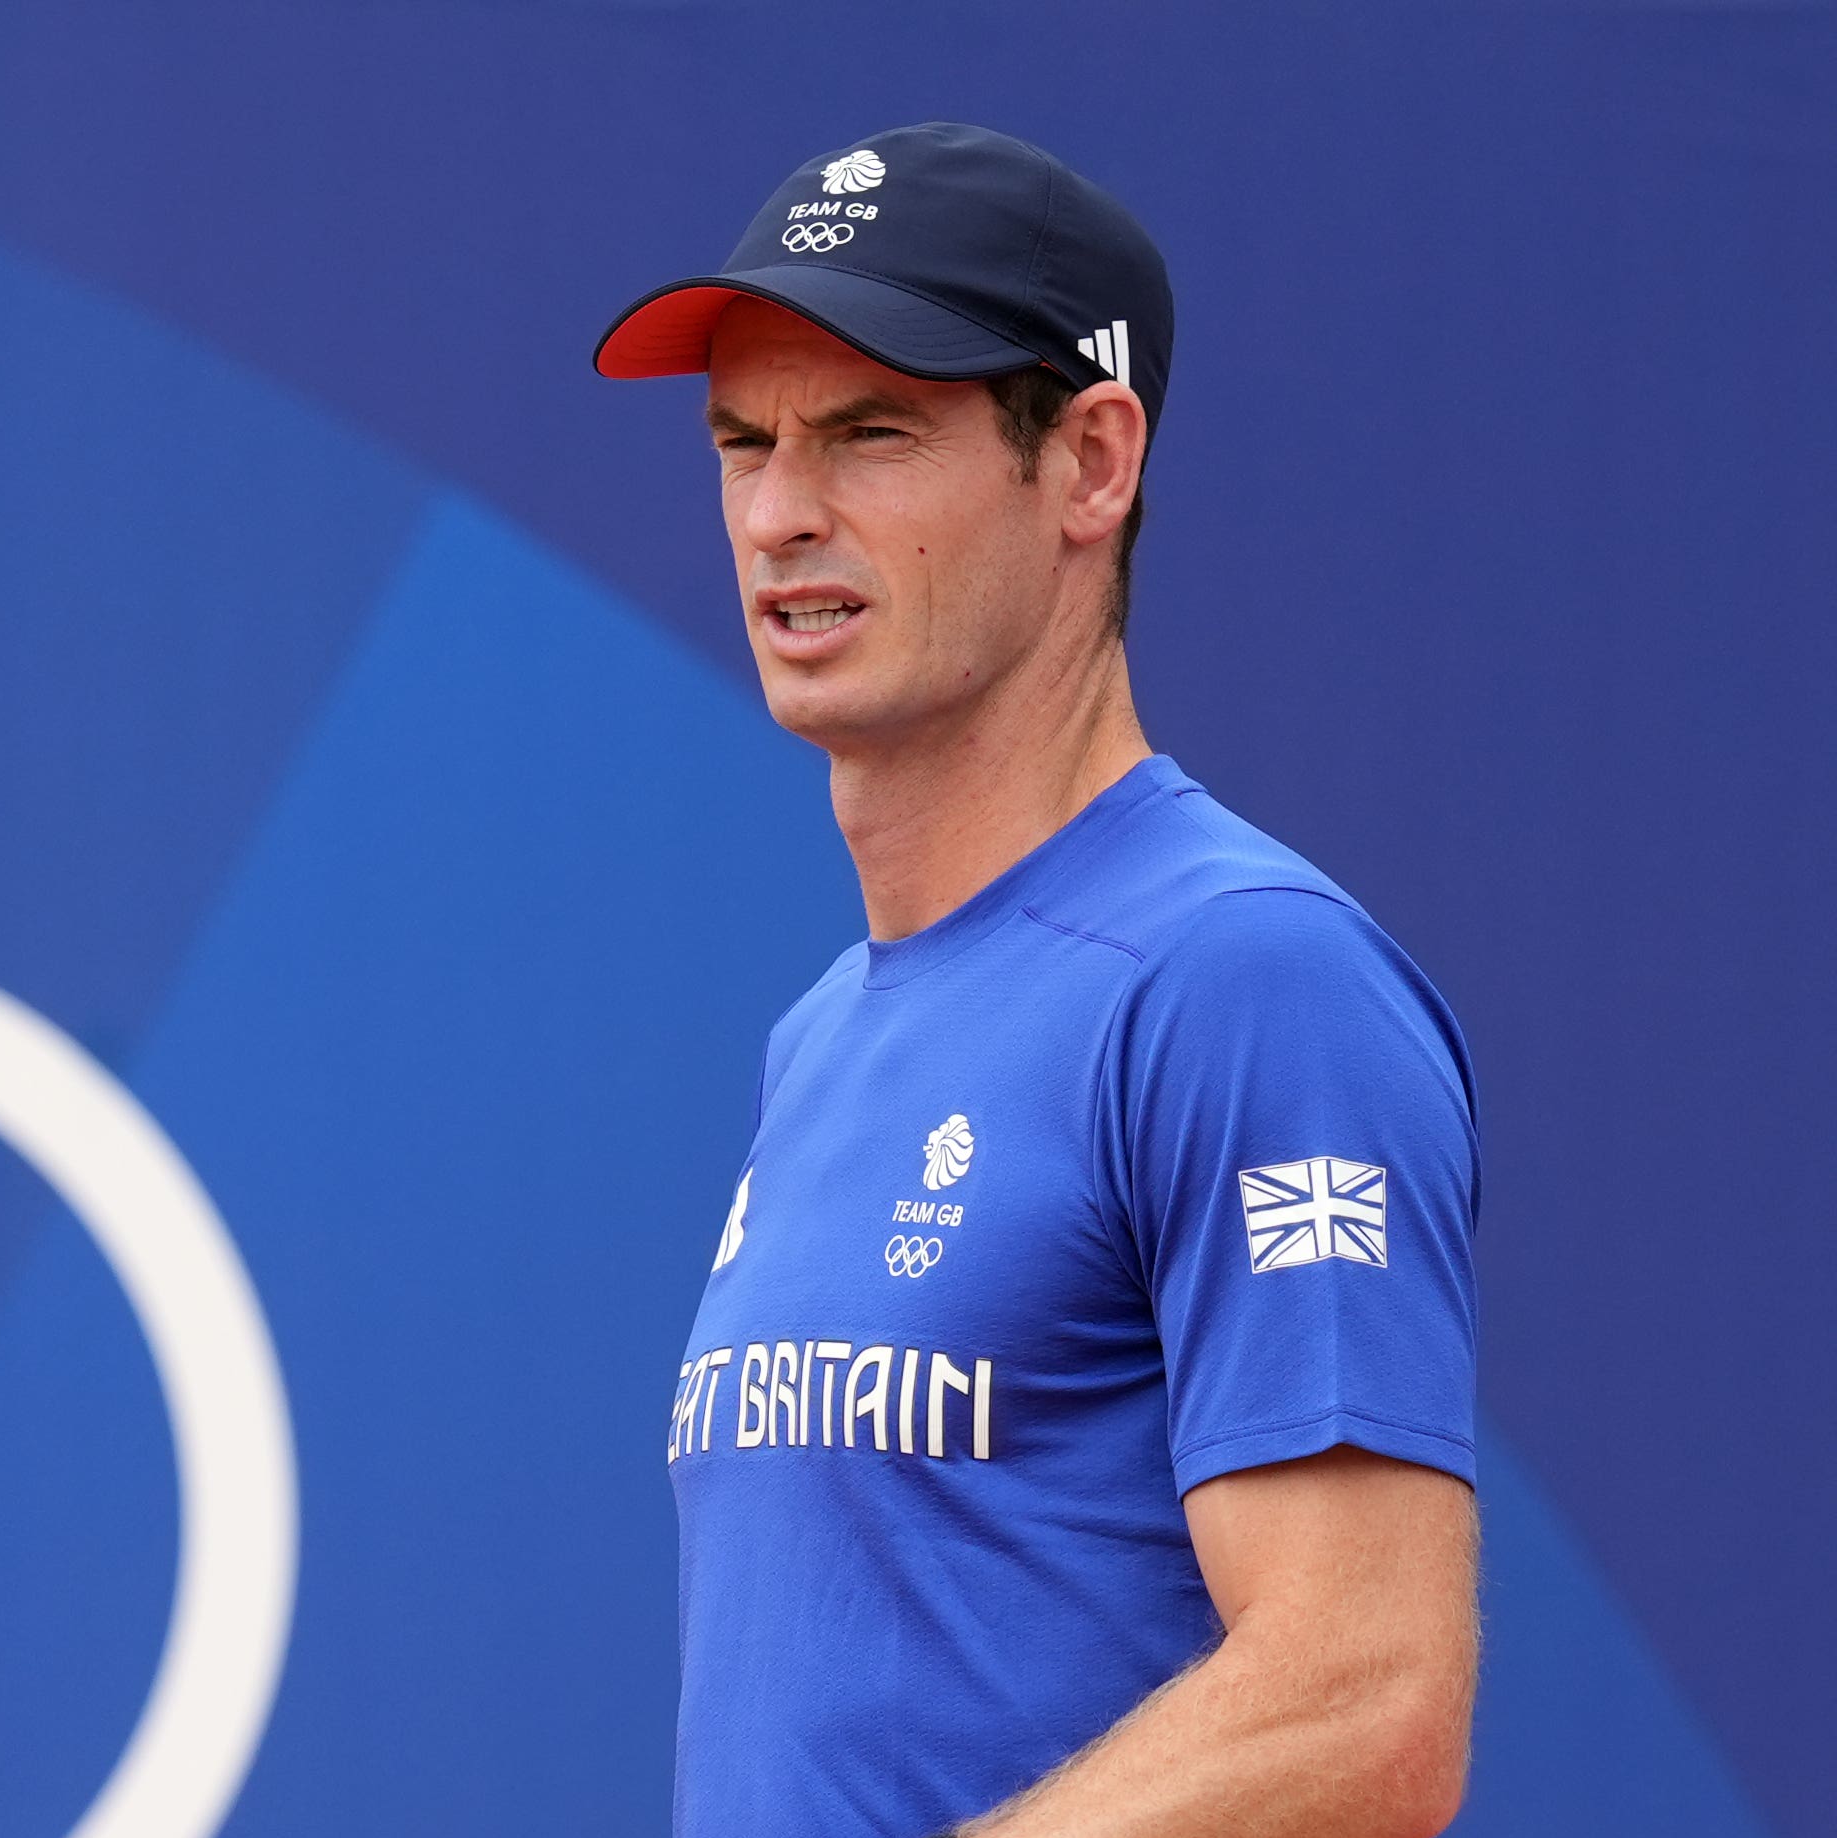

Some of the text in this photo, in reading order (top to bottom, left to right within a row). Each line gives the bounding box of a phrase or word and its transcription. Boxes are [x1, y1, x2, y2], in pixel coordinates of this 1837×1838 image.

[787, 201, 879, 221] TEAM GB
[891, 1200, 964, 1227] TEAM GB
[667, 1338, 993, 1467] EAT BRITAIN
